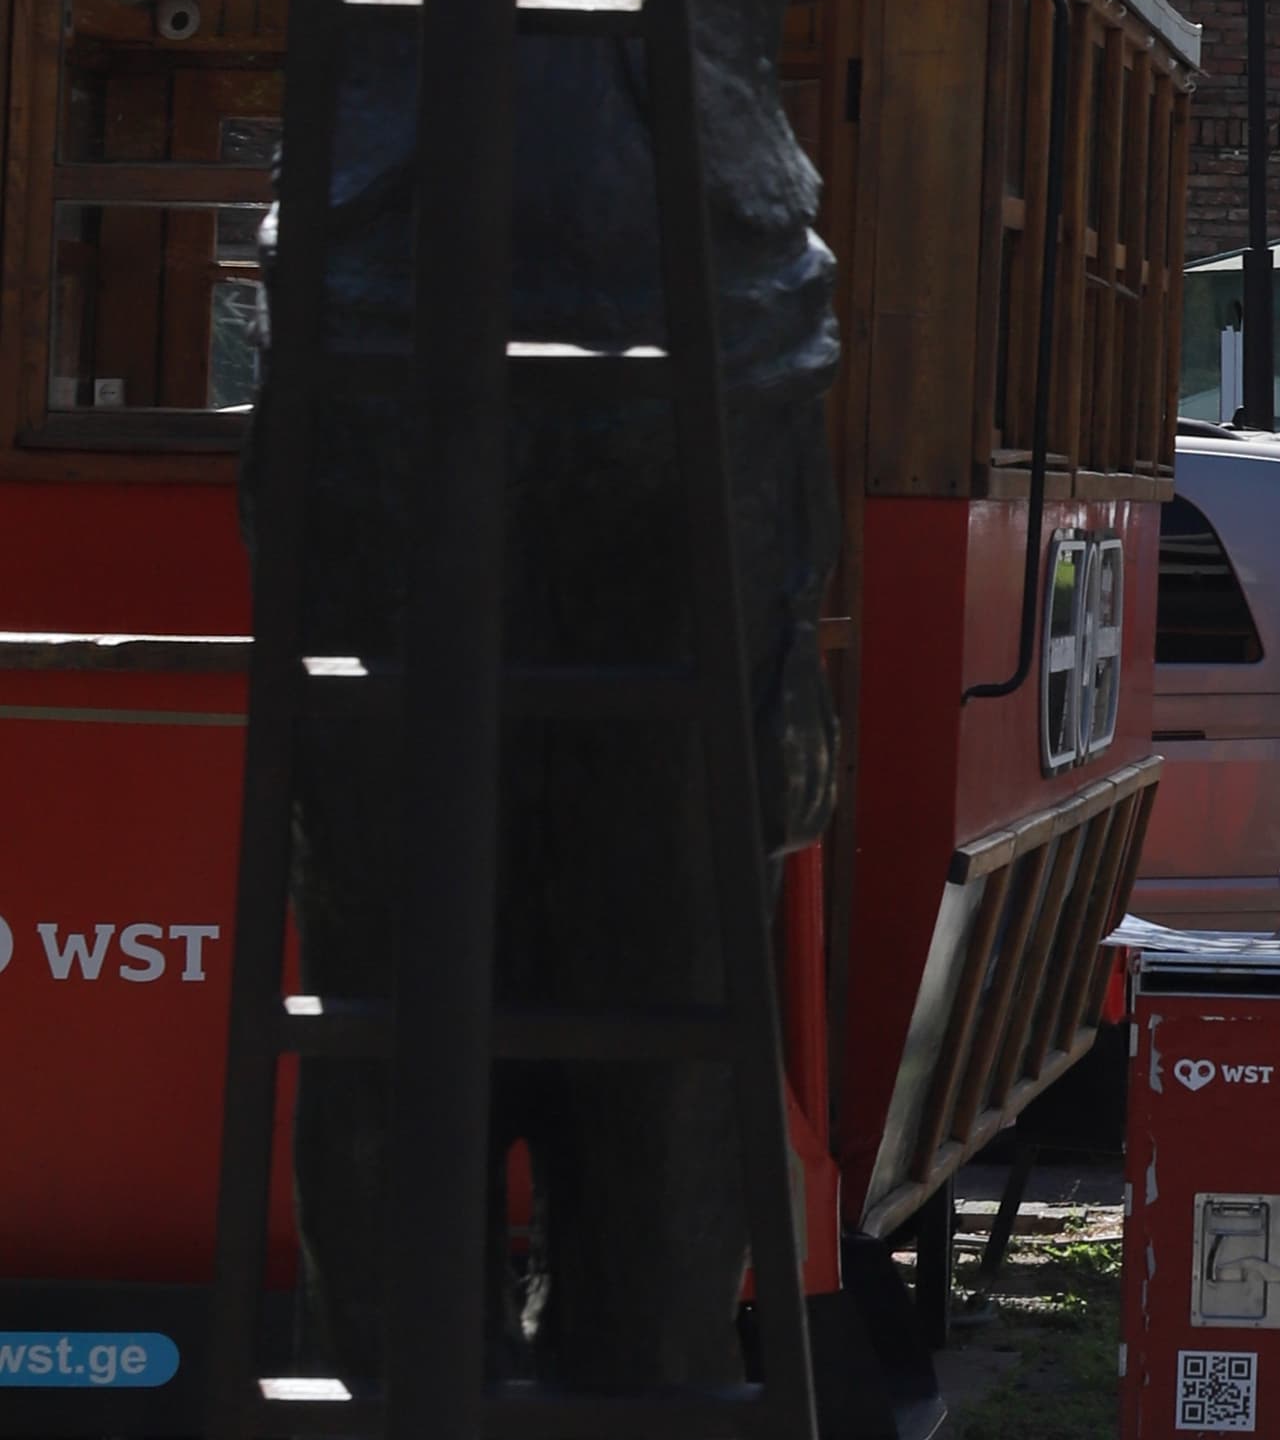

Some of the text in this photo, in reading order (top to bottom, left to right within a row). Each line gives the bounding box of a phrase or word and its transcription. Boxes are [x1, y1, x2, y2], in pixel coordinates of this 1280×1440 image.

[37, 924, 220, 982] WST
[1222, 1065, 1274, 1085] WST
[0, 1336, 148, 1384] wst.ge
